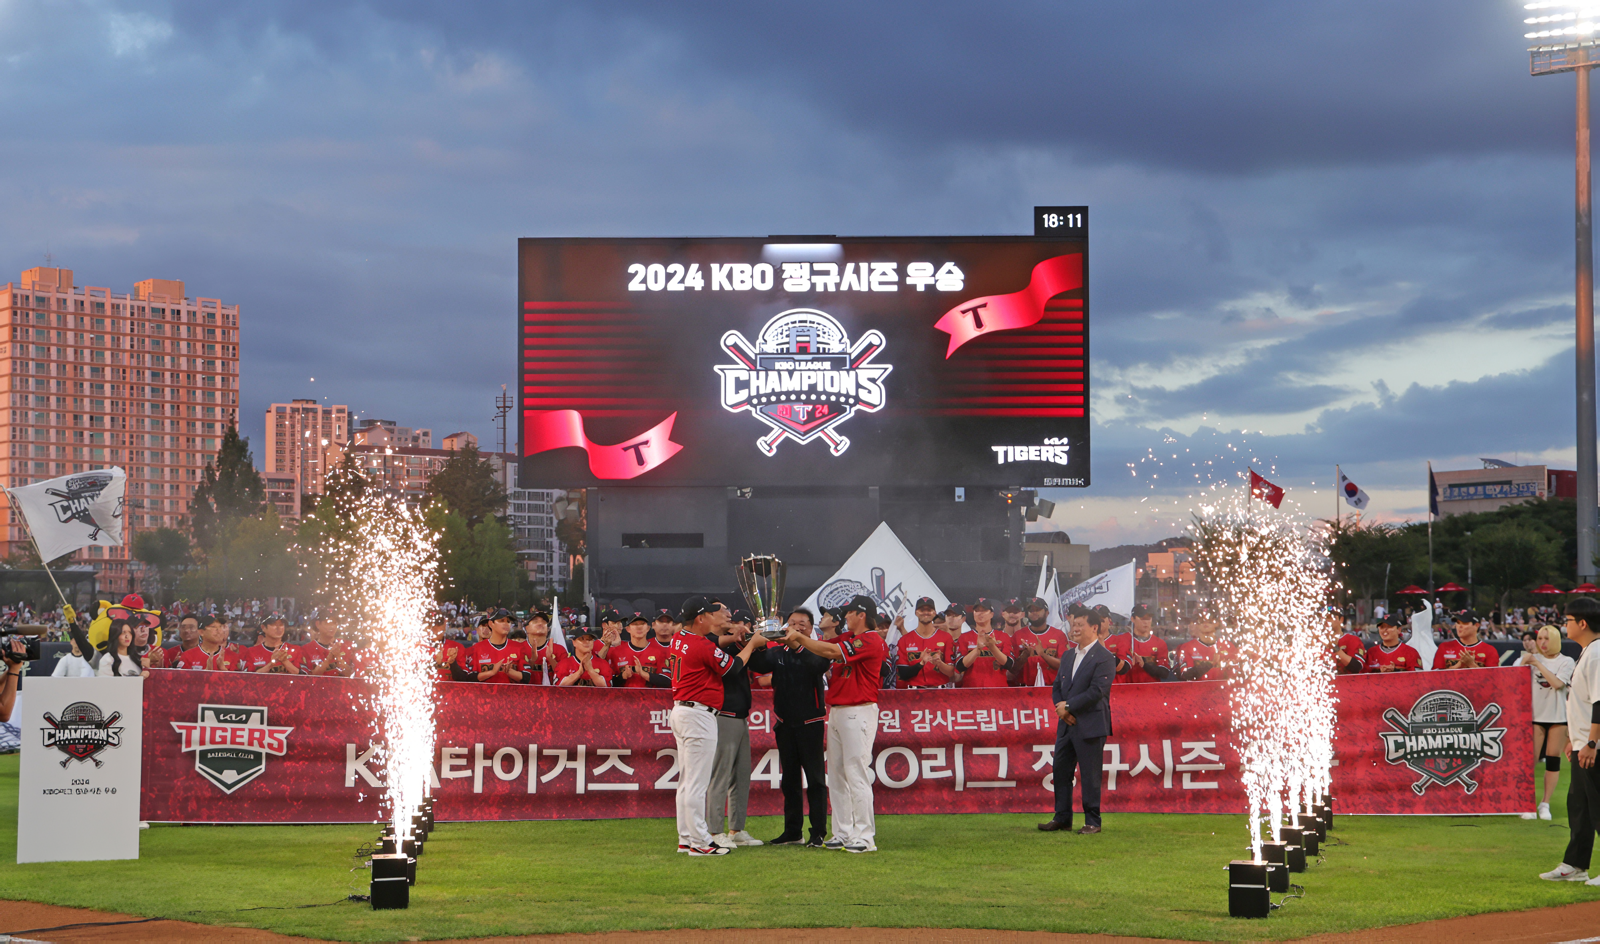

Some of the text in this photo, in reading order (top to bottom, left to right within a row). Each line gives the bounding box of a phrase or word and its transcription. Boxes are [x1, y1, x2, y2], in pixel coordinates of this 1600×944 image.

[1042, 213, 1082, 228] 18:11
[627, 263, 704, 291] 2024
[711, 263, 774, 291] KBO
[906, 261, 965, 292] 우승
[795, 361, 831, 370] LEAGUE
[724, 369, 886, 406] CHAMPIONS
[991, 445, 1070, 466] TIGERS
[911, 708, 1050, 733] 감사드립니다!
[175, 724, 288, 754] TIGERS
[1386, 730, 1503, 760] CHAMPIONS
[345, 743, 639, 794] K타이거즈
